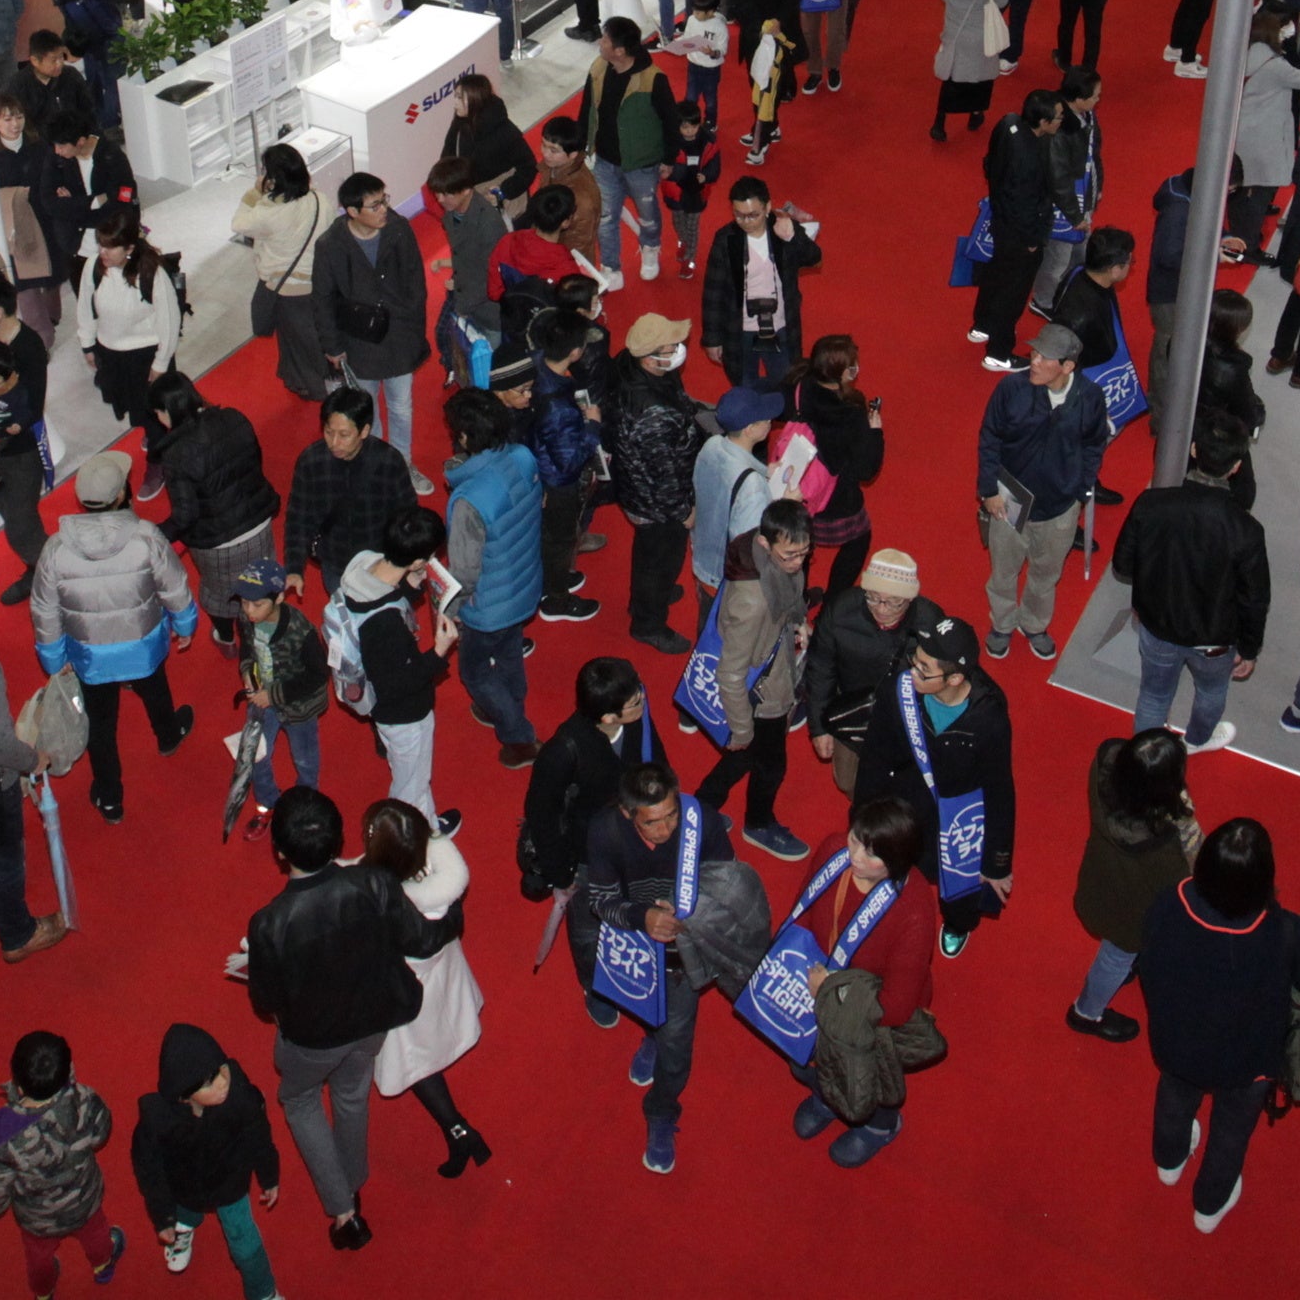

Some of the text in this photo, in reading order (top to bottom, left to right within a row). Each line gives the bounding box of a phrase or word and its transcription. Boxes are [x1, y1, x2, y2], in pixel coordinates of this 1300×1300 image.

[422, 64, 476, 112] SUZUKI
[1102, 372, 1130, 396] フィア
[901, 674, 922, 746] SPHERE LIGHT
[678, 828, 698, 914] SPHERE LIGHT
[857, 889, 890, 929] SPHERE
[606, 928, 650, 964] スフィア
[609, 949, 646, 979] ライト
[762, 980, 810, 1020] LIGHT
